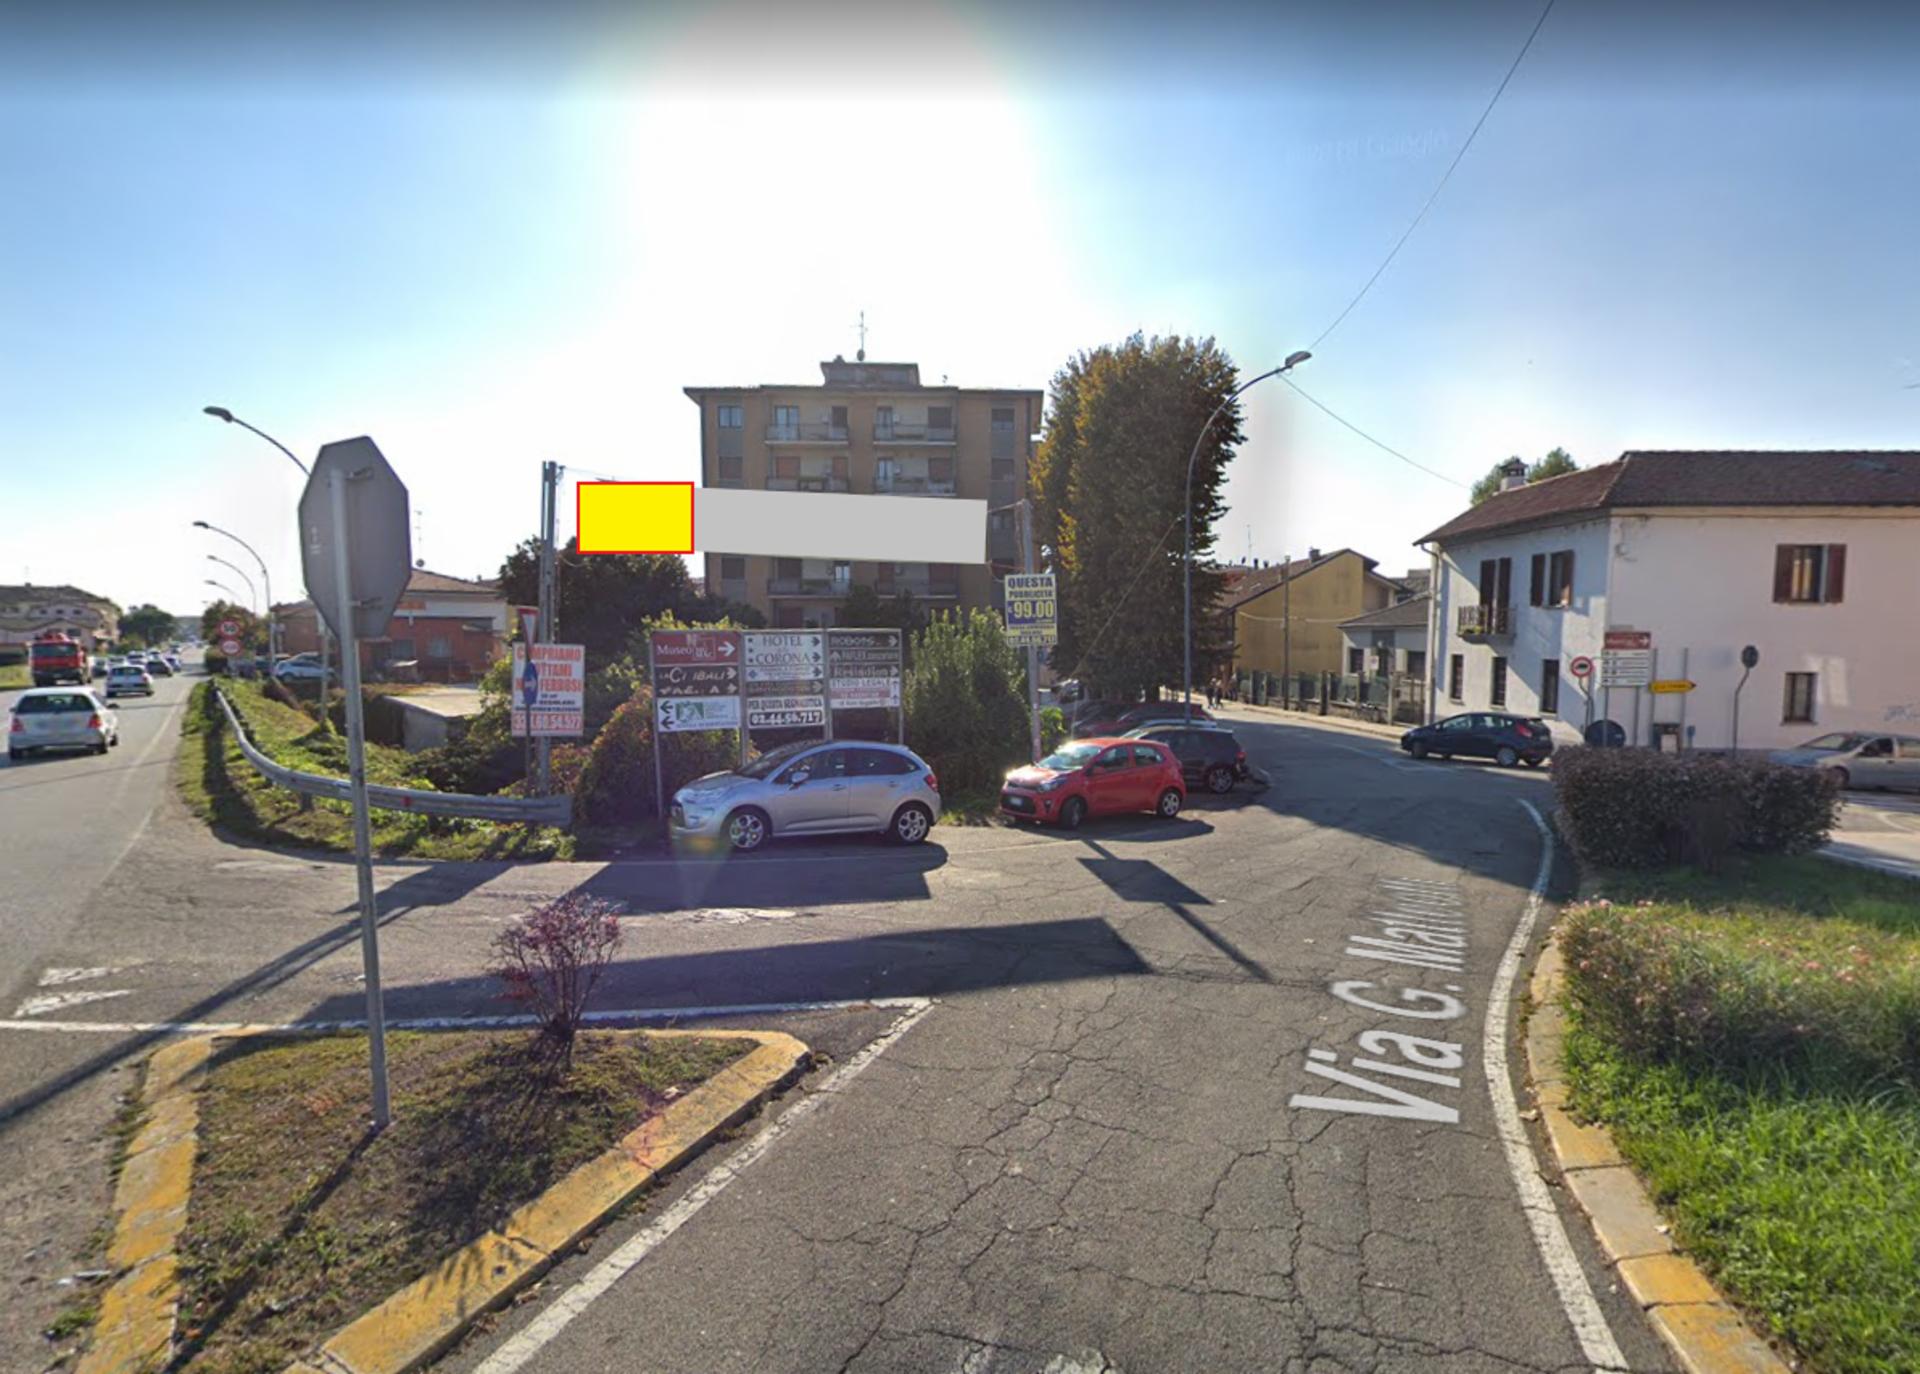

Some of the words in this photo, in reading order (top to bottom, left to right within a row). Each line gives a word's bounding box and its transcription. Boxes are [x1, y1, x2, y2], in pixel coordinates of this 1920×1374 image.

[1008, 577, 1053, 589] QUESTA
[763, 635, 802, 647] HOTEL
[516, 645, 582, 660] CMPRIAMO
[656, 644, 693, 656] Museo
[755, 652, 811, 665] CORONA
